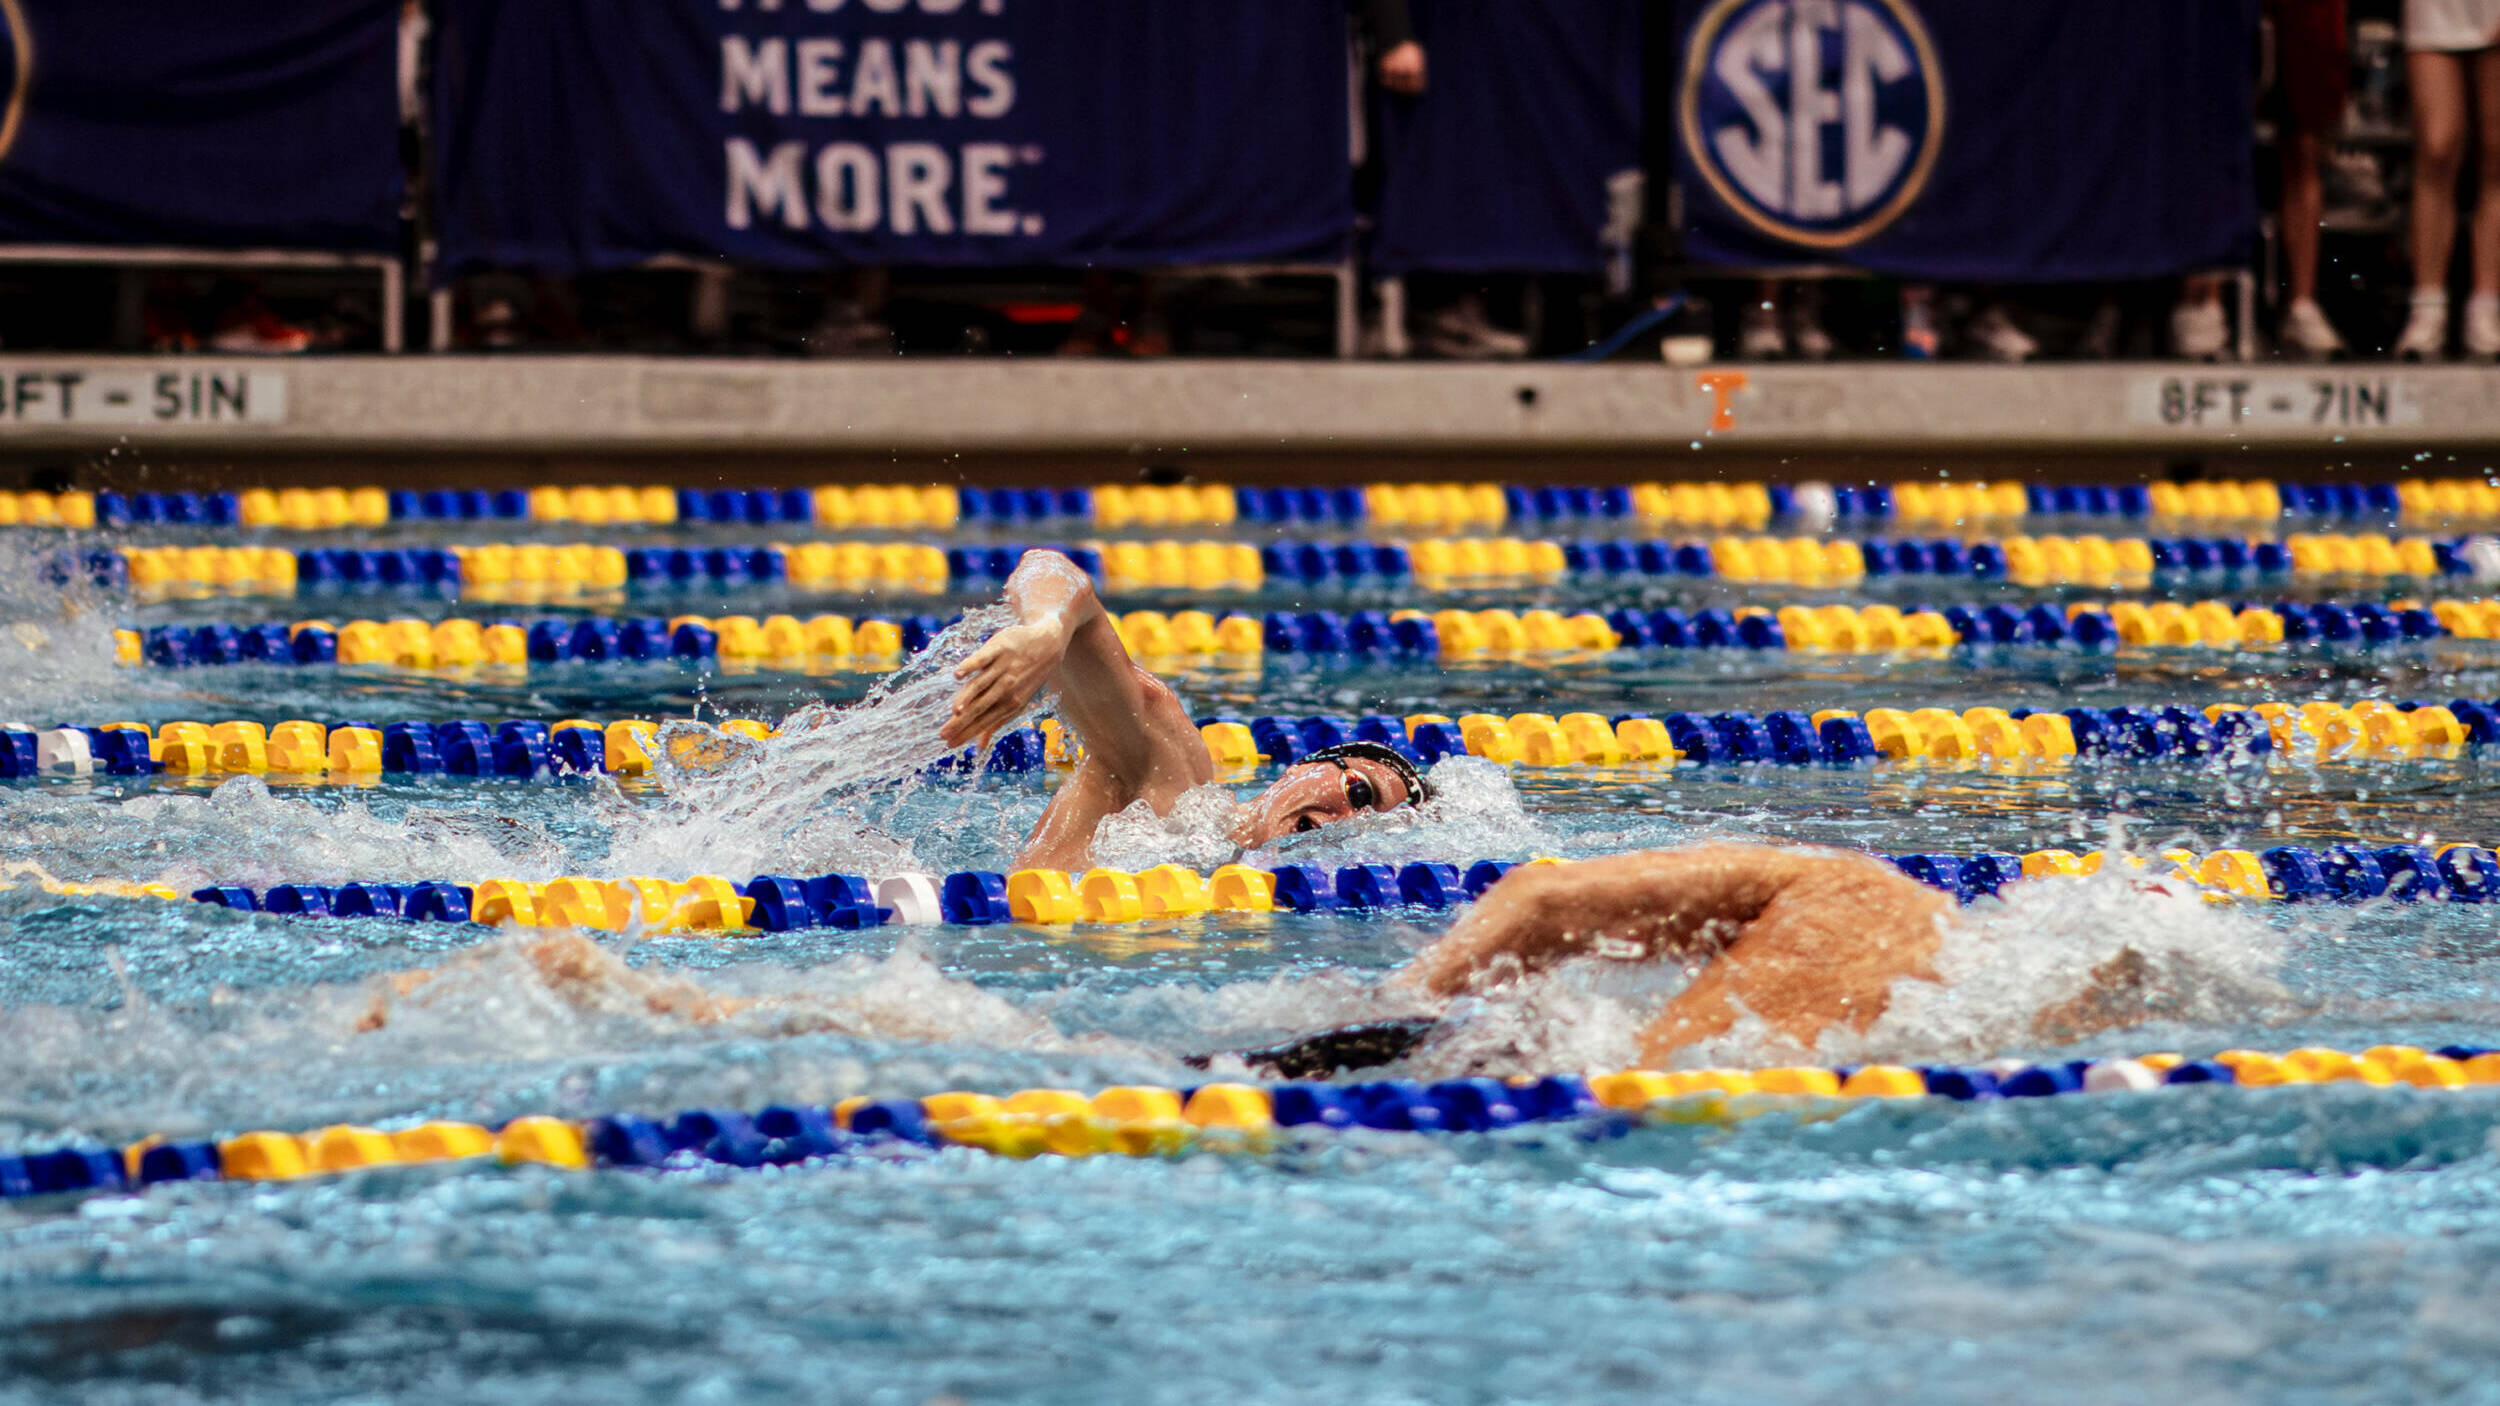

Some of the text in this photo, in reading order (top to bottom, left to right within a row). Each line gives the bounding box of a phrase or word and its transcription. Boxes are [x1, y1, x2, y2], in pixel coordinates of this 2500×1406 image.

[720, 36, 1016, 118] MEANS
[1714, 0, 1912, 218] SEC
[724, 138, 1045, 236] MORE.
[0, 371, 84, 418] FT
[152, 372, 246, 418] 5IN
[2160, 376, 2249, 424] 8FT
[2310, 377, 2389, 424] 7IN
